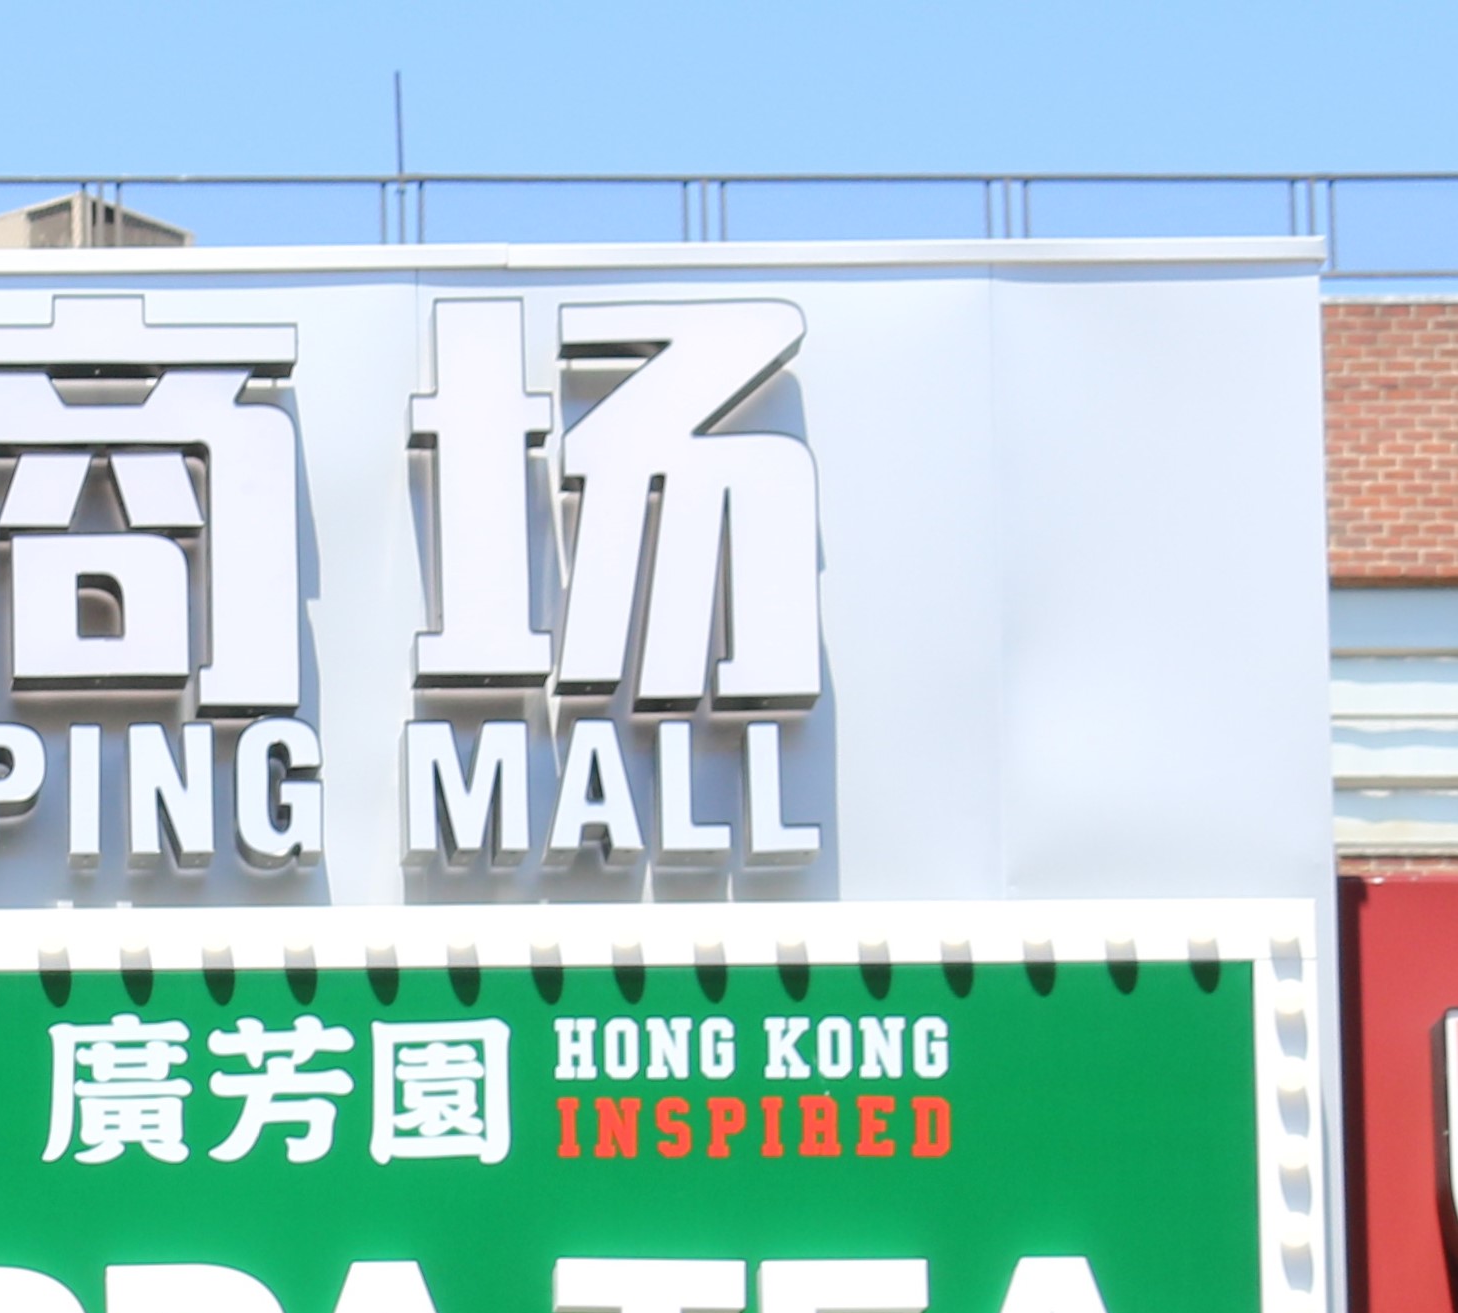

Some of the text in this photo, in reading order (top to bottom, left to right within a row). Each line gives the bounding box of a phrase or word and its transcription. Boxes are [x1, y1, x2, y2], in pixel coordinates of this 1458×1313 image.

[403, 718, 823, 868] MALL
[42, 1011, 514, 1168] 廣芳園
[554, 1015, 952, 1081] HONG KONG
[555, 1094, 954, 1160] INSPIRED
